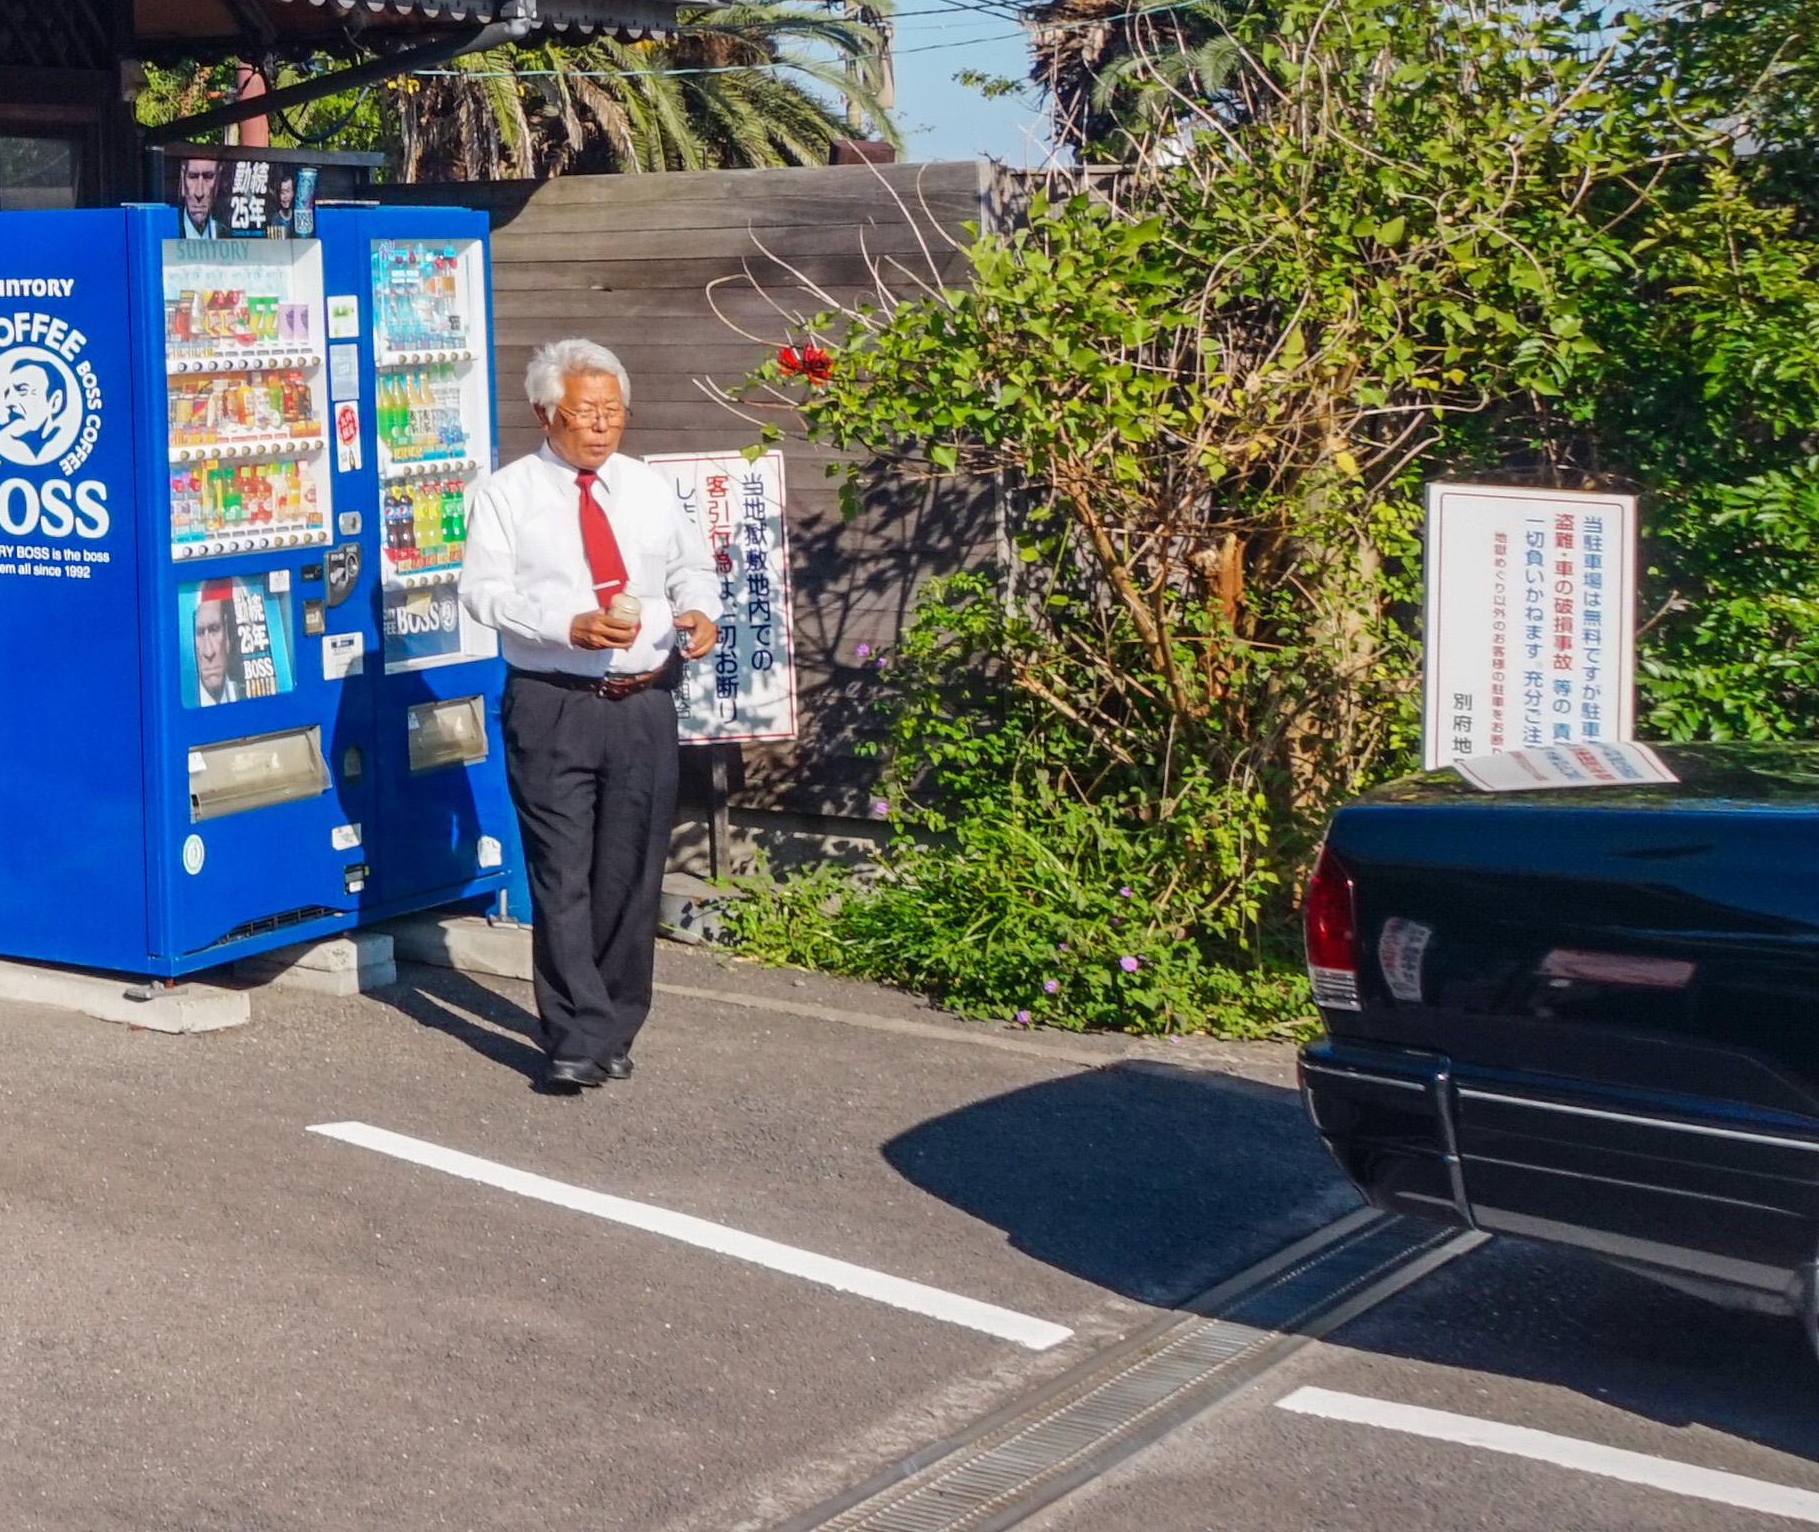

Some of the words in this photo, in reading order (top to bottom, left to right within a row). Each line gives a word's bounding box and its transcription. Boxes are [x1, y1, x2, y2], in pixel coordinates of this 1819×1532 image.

[230, 195, 267, 230] 25年
[75, 360, 103, 411] BOSS
[58, 413, 102, 477] COFFEE
[16, 544, 50, 561] BOSS
[51, 547, 62, 561] is
[64, 547, 81, 562] the
[82, 548, 111, 564] boss
[17, 562, 32, 576] all
[33, 563, 63, 578] since
[64, 564, 91, 579] 1992
[742, 472, 774, 671] 当地獄敷地内での
[237, 623, 270, 654] 25年
[1580, 515, 1603, 744] 当駐車場は無料ですが駐車
[243, 657, 275, 680] BOSS
[1452, 693, 1473, 764] 別府地
